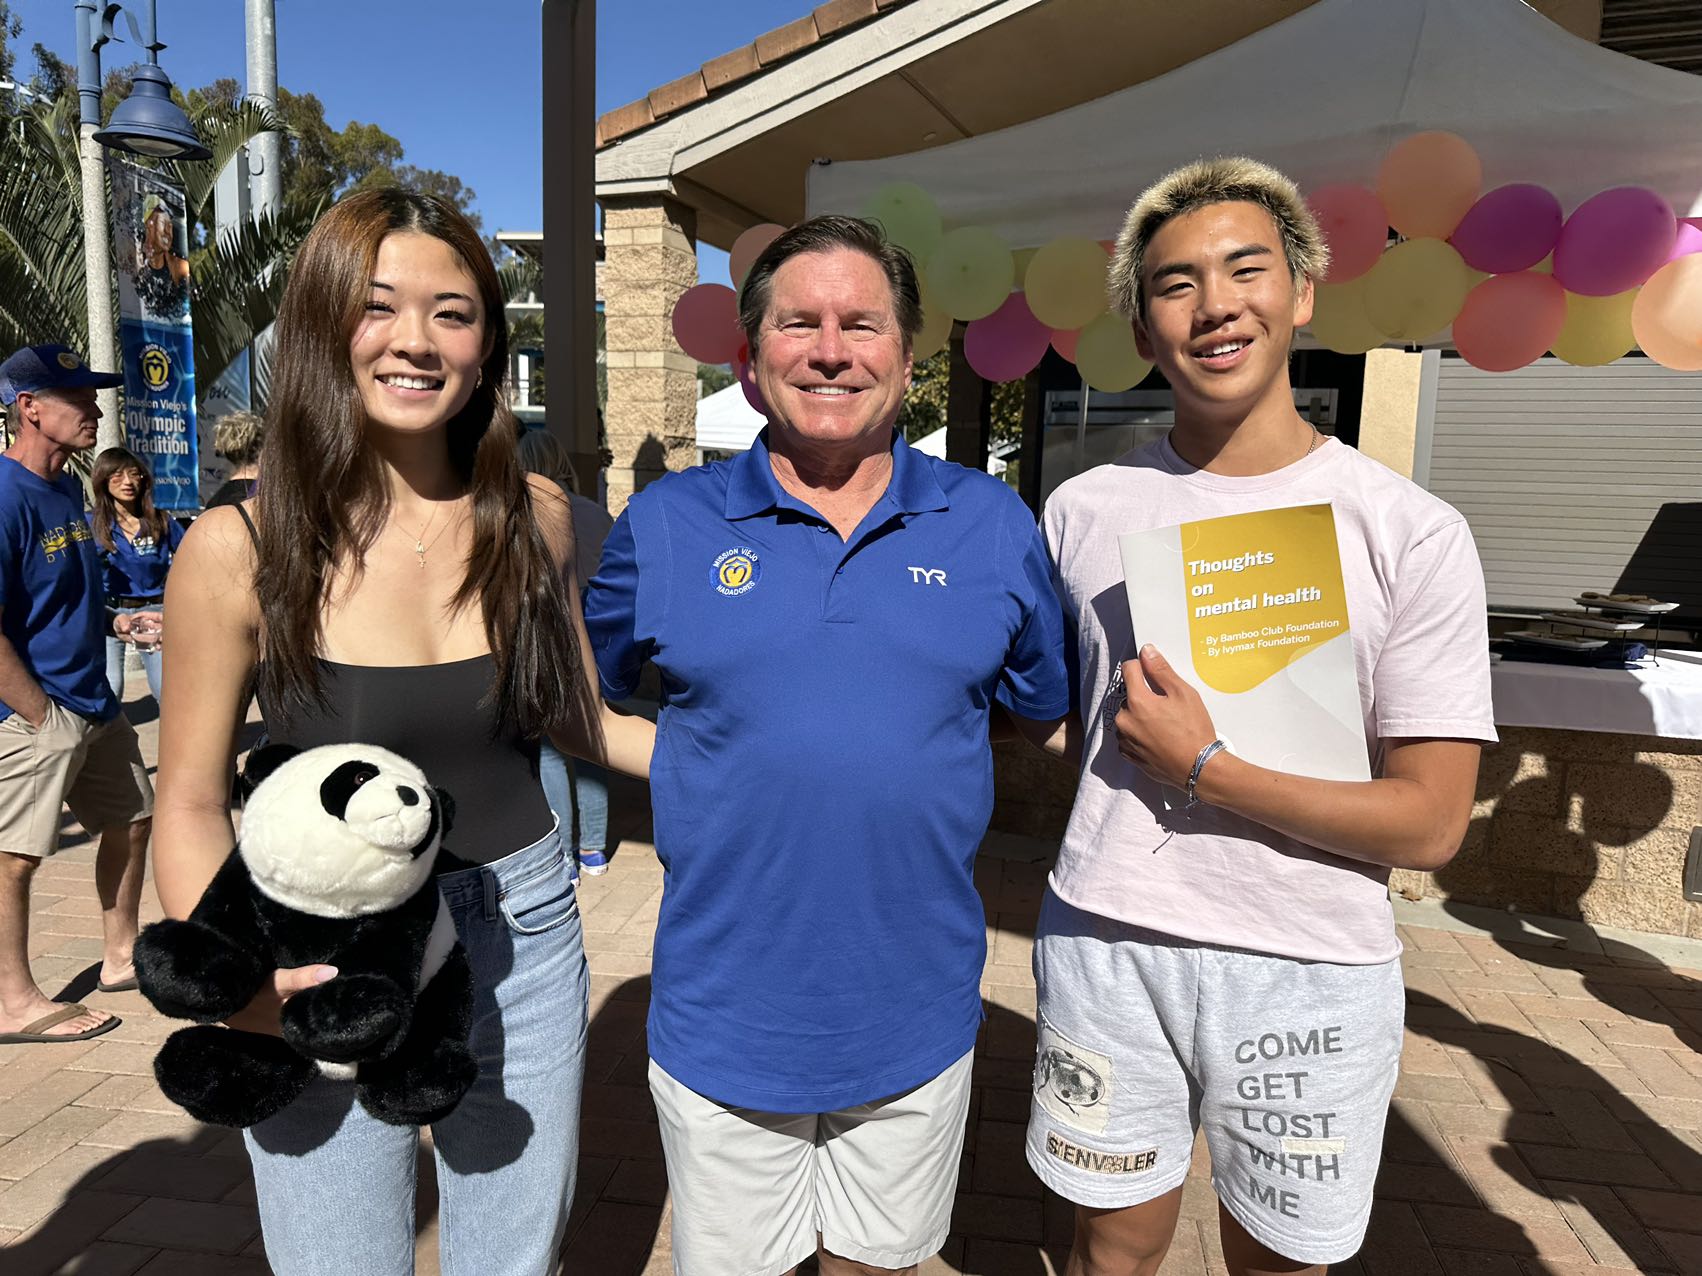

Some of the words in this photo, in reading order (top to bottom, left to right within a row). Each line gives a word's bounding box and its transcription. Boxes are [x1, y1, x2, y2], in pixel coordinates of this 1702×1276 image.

[126, 397, 158, 409] Mission
[160, 399, 187, 412] Viejo's
[130, 411, 186, 435] Olympic
[128, 434, 188, 455] Tradition
[713, 548, 739, 568] MISSION
[741, 548, 758, 562] VIEJO
[1188, 551, 1275, 576] Thoughts
[716, 580, 755, 595] NADADORES
[907, 566, 947, 586] TYR
[1191, 582, 1214, 597] on
[1195, 594, 1258, 618] mental
[1263, 586, 1321, 608] health
[1206, 635, 1218, 646] By
[1220, 629, 1260, 643] Bamboo
[1261, 627, 1284, 637] Club
[1285, 618, 1340, 633] Foundation
[1208, 646, 1220, 657] By
[1222, 642, 1255, 656] Ivymax
[1257, 635, 1310, 648] Foundation
[1234, 1026, 1343, 1064] COME
[1237, 1072, 1308, 1100] GET
[1242, 1108, 1336, 1138] LOST
[1248, 1142, 1340, 1181] WITH
[1249, 1174, 1300, 1219] ME
